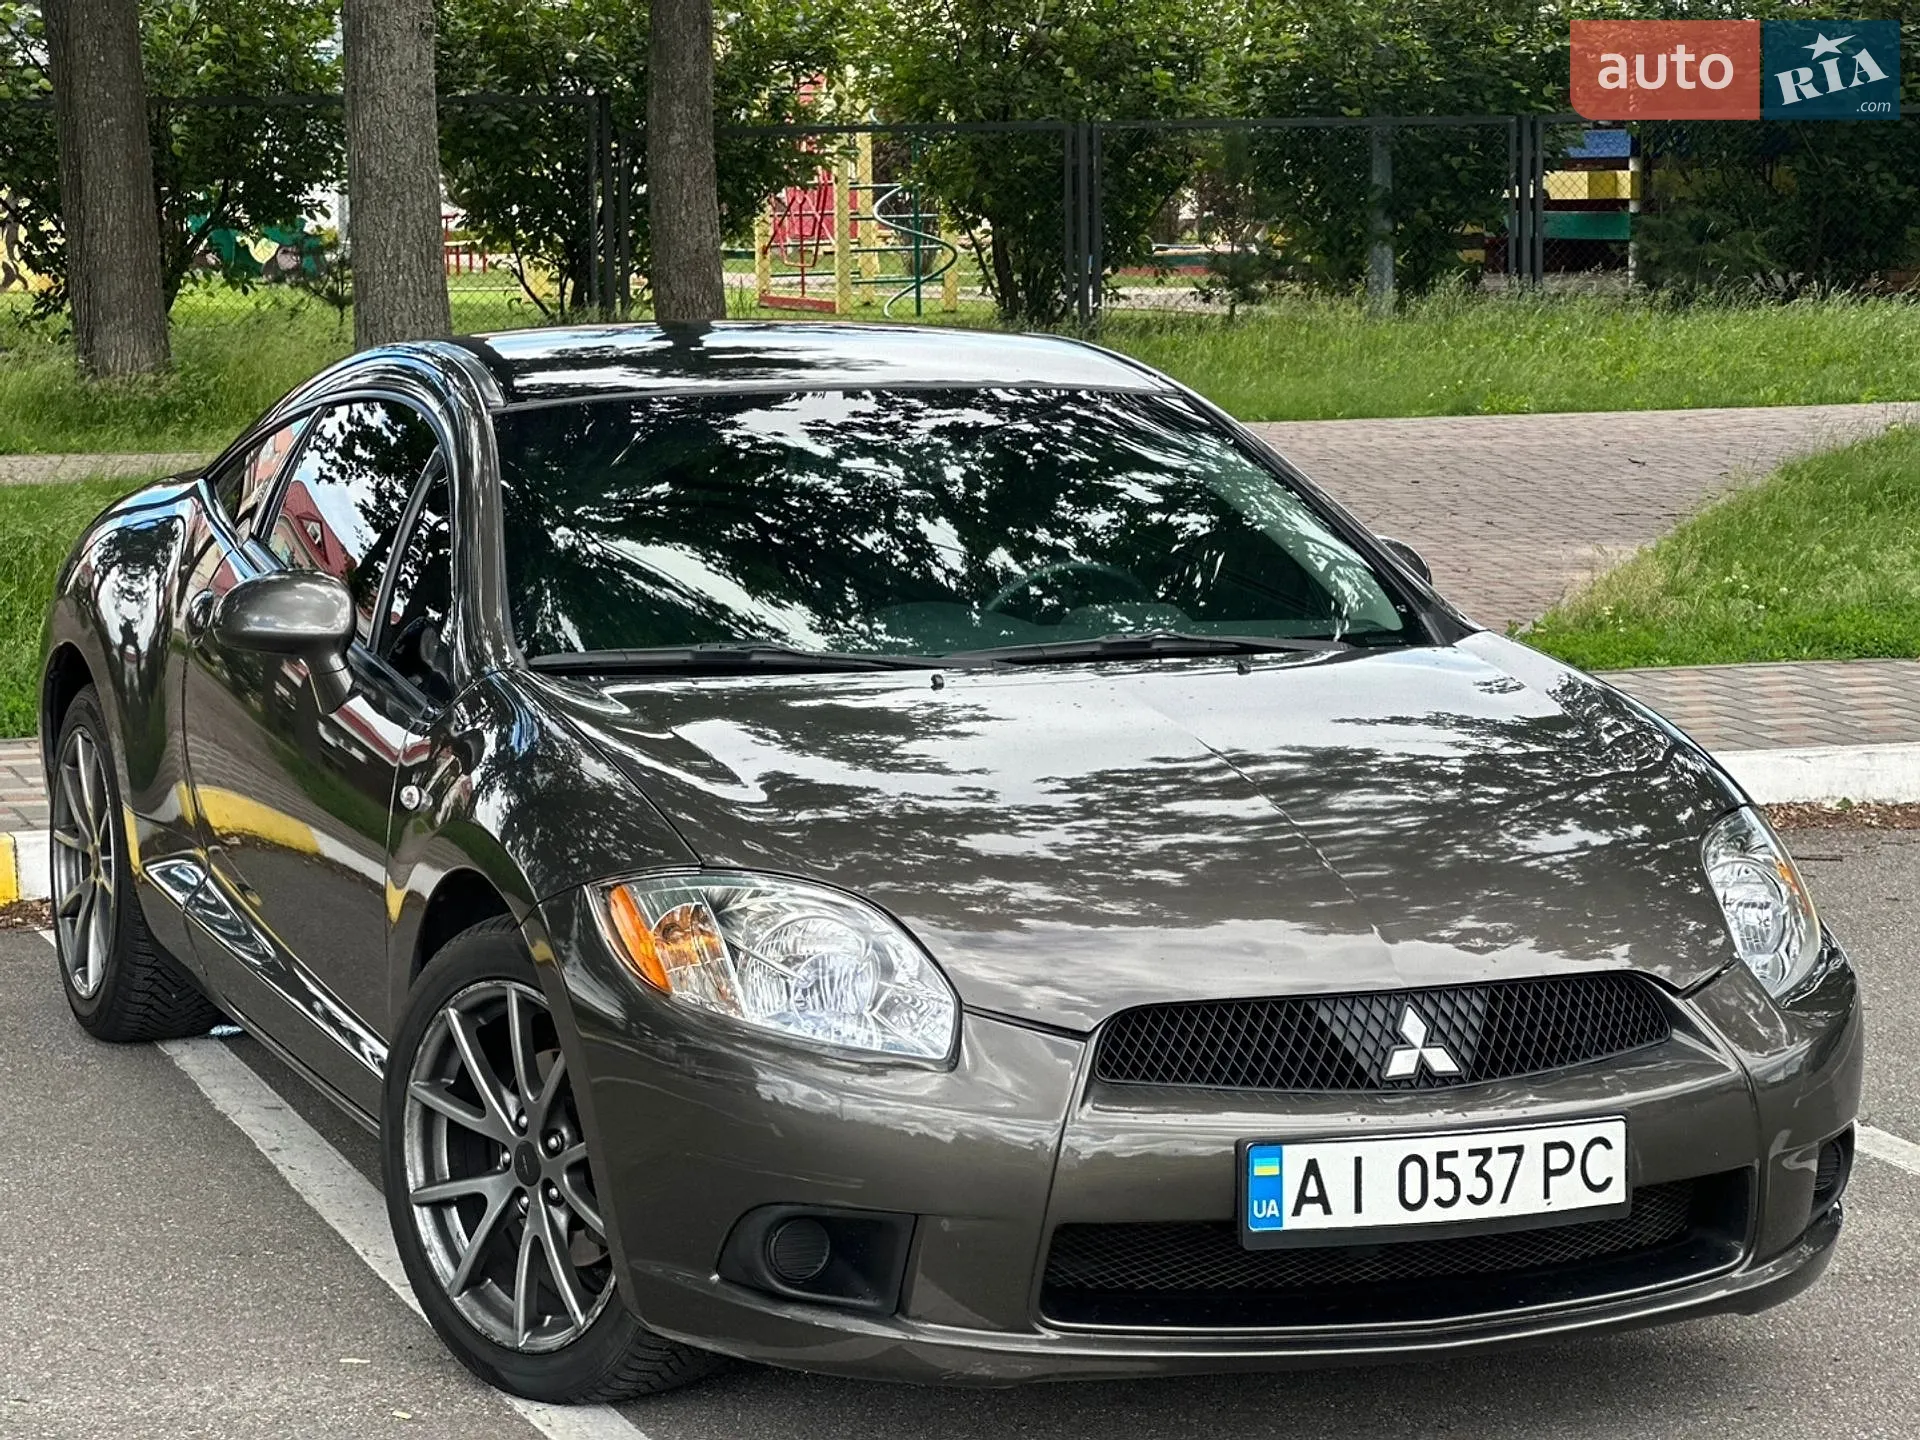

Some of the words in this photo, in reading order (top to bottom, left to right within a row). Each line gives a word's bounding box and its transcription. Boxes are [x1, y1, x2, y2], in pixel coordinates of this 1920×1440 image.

[1291, 1156, 1362, 1217] AI
[1399, 1145, 1525, 1212] 0537
[1543, 1136, 1614, 1200] PC
[1253, 1200, 1280, 1219] UA
